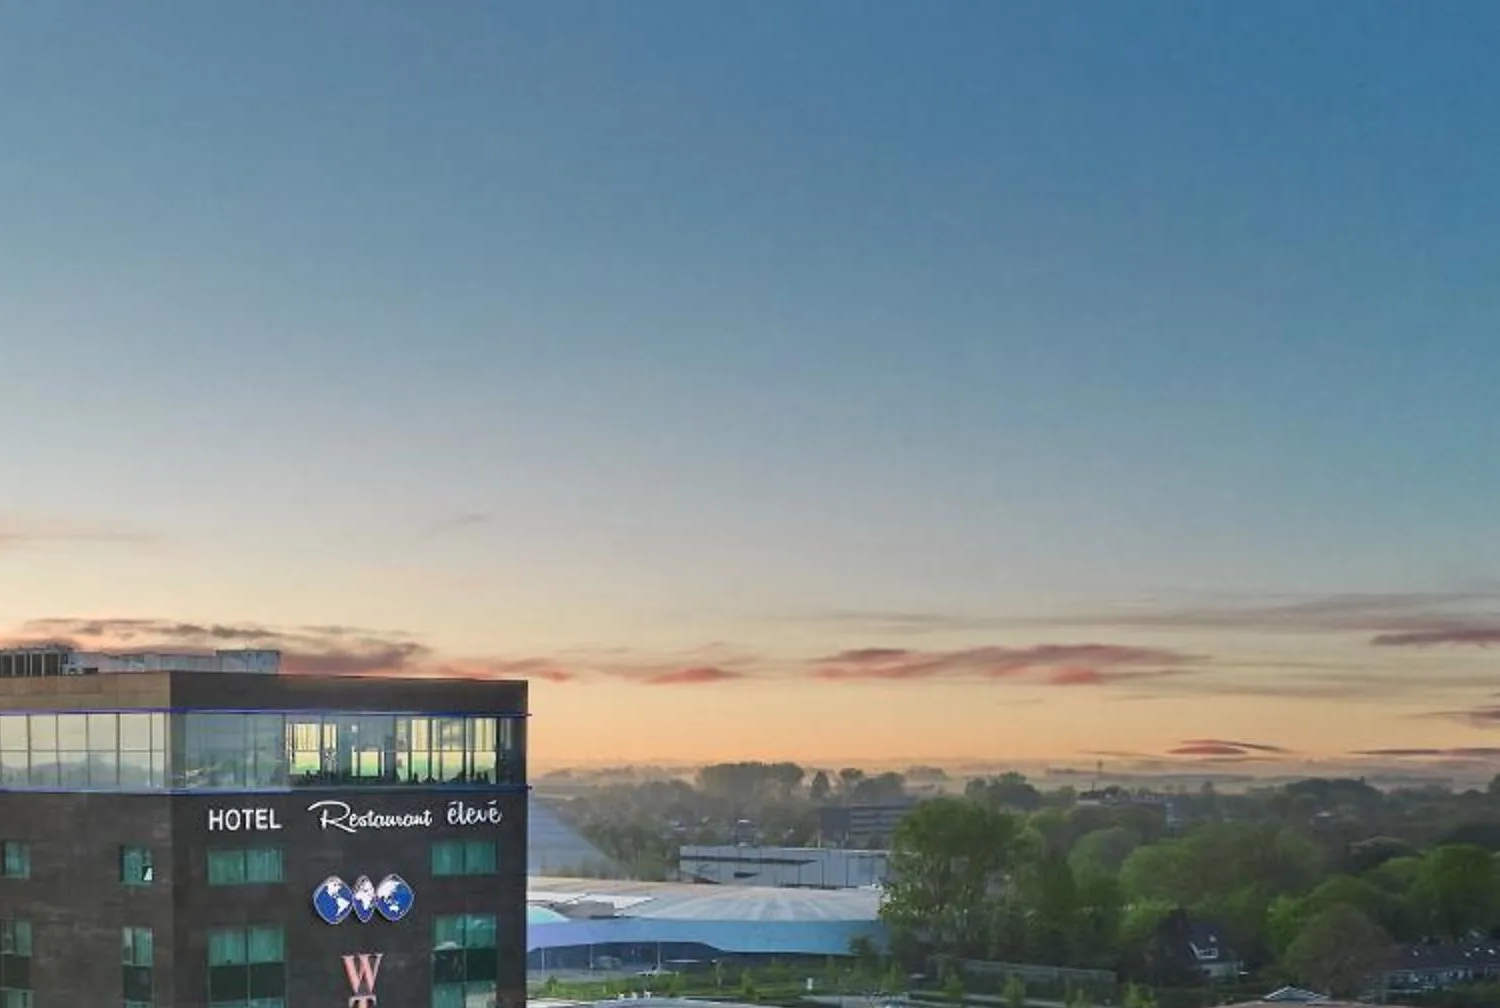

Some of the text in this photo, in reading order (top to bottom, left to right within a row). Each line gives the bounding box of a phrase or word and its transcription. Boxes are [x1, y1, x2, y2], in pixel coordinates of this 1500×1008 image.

[209, 808, 282, 830] HOTEL
[307, 800, 501, 833] Restaurant élevé
